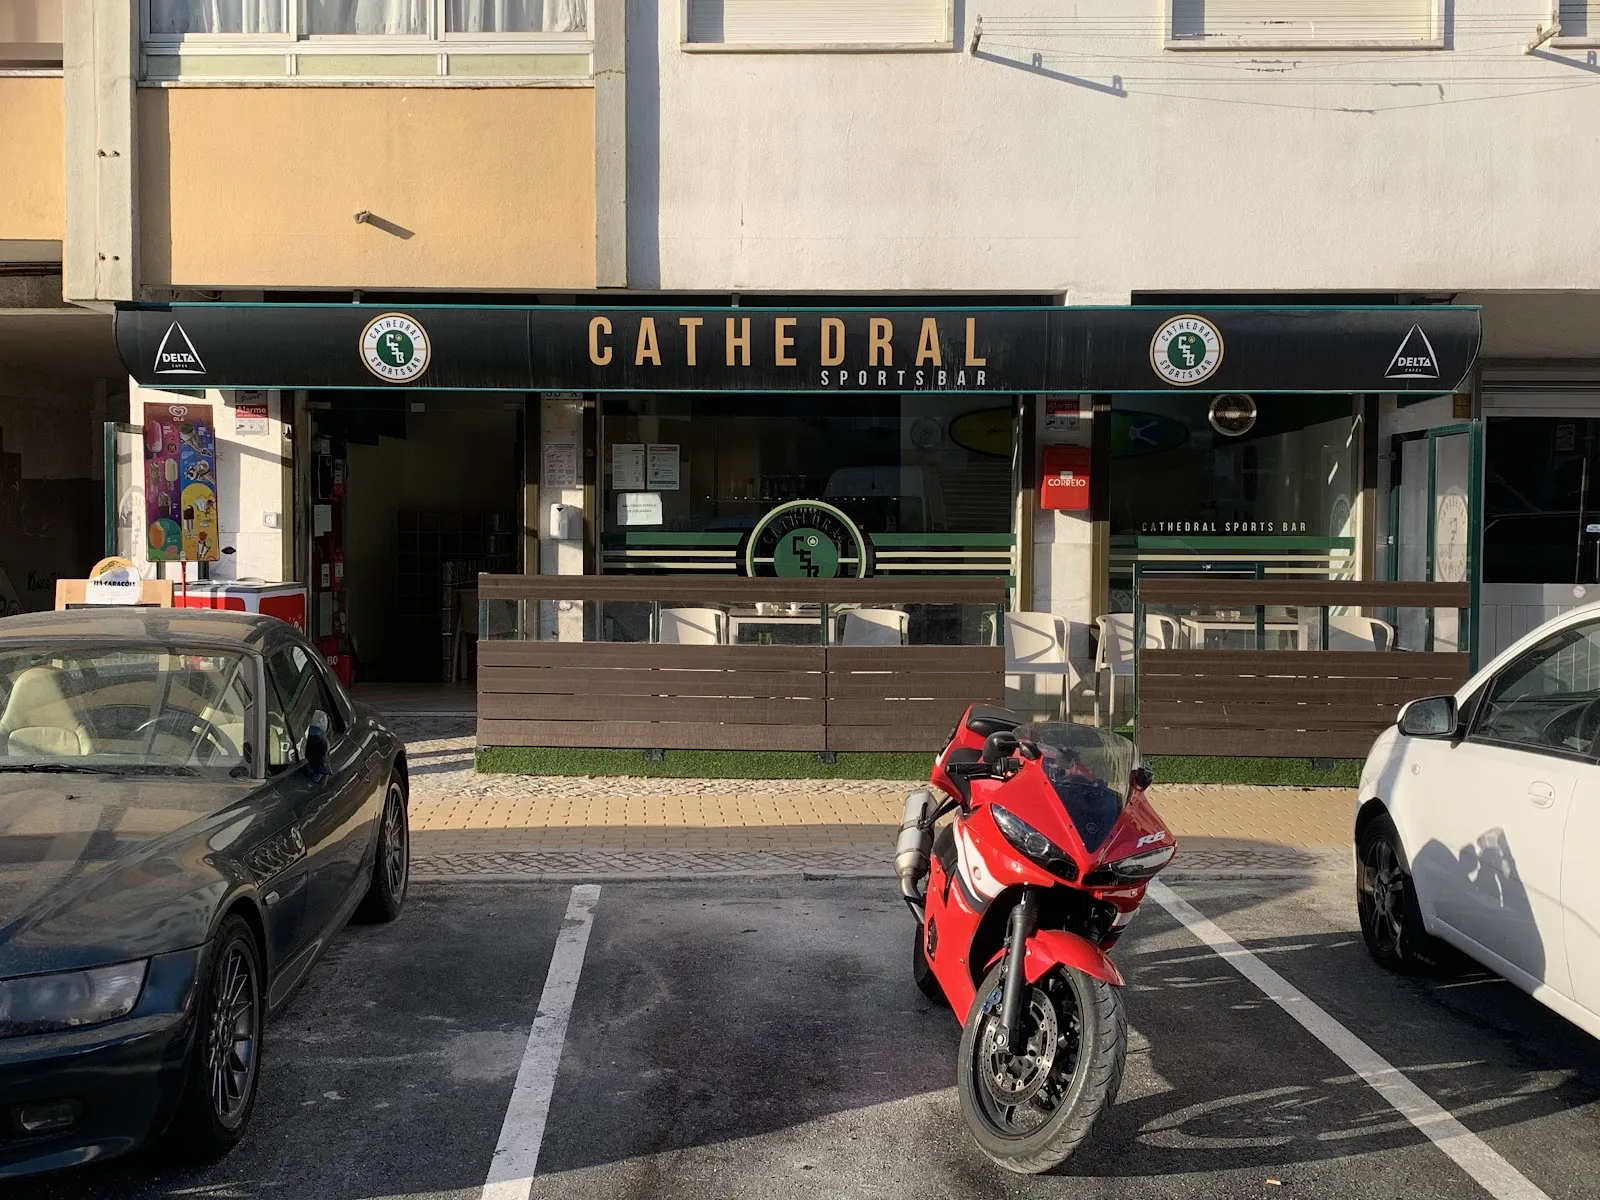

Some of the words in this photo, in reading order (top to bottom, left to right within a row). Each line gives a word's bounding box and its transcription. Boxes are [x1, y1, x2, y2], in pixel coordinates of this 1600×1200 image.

[369, 319, 421, 342] CATHEDRAL
[1161, 321, 1214, 343] CATHEDRAL
[588, 316, 987, 367] CATHEDRAL
[162, 353, 195, 363] DELTA
[371, 356, 422, 376] SPORTSBAR
[1397, 356, 1432, 367] DELTA
[1160, 359, 1212, 379] SPORTSBAR
[820, 370, 987, 387] SPORTSBAR
[237, 405, 267, 414] Alarme
[1048, 478, 1086, 487] CORREIO
[1142, 521, 1217, 532] CATHEDRAL
[1225, 521, 1274, 532] SPORTS
[1283, 521, 1306, 532] BAR
[1136, 830, 1166, 848] R6
